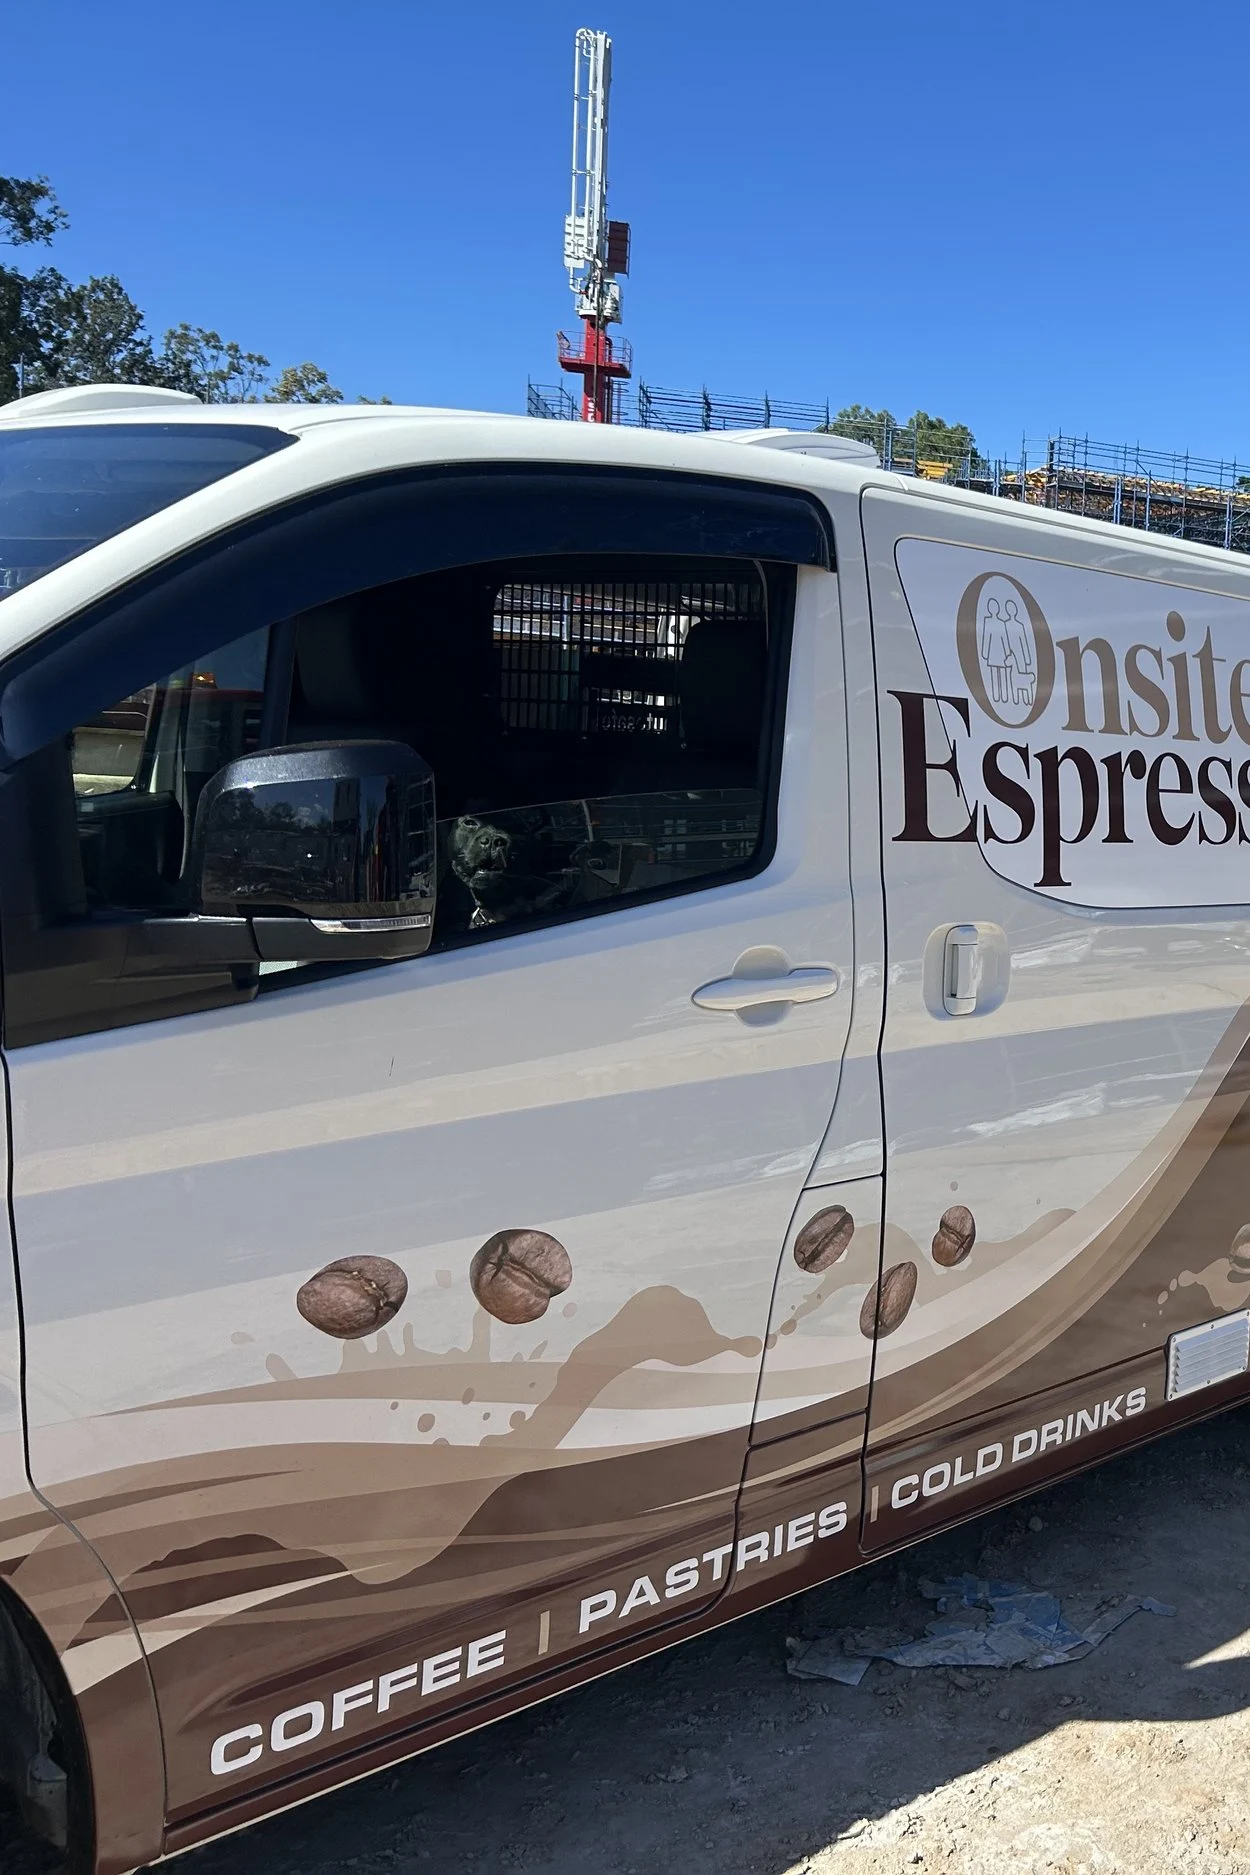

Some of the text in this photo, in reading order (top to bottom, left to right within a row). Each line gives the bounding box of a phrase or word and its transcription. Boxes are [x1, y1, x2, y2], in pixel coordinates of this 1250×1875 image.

[210, 1386, 1147, 1777] COFFEE PASTRIES COLD DRINKS
